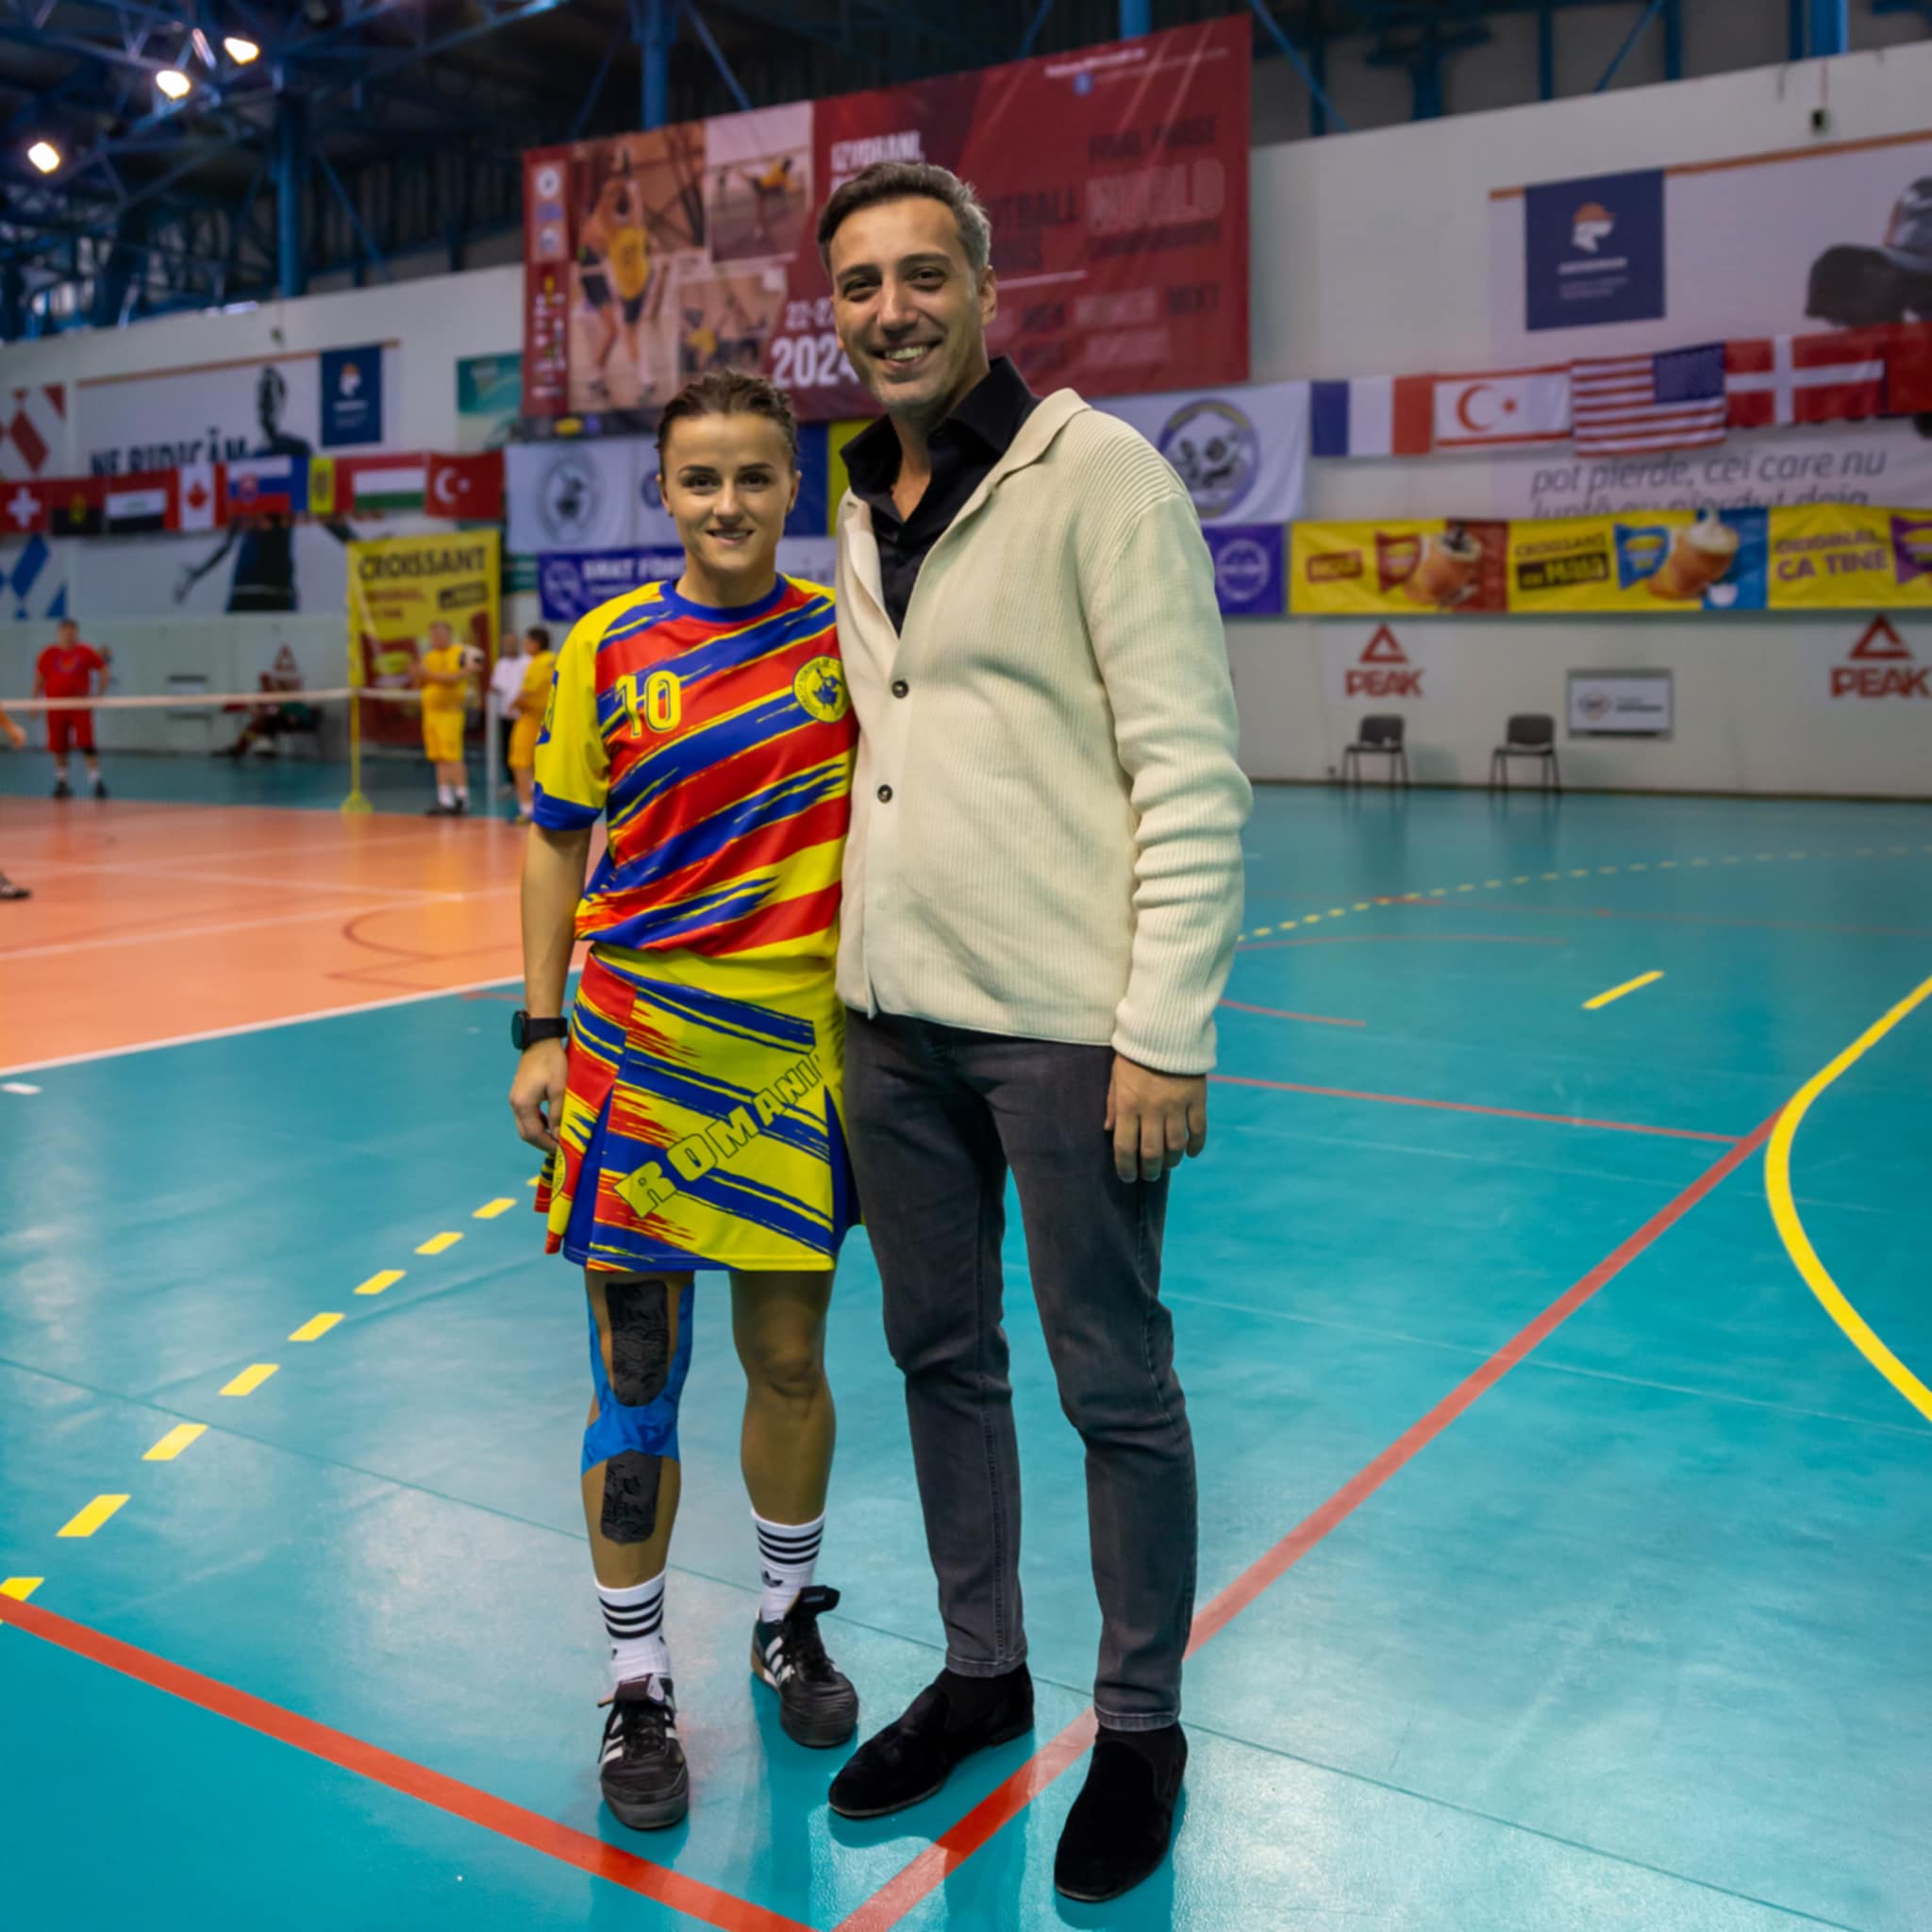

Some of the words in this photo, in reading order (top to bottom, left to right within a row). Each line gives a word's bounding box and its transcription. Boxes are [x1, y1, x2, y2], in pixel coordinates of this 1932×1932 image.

[1530, 465, 1581, 502] pot
[1585, 453, 1695, 510] pierde,
[1705, 449, 1753, 484] cei
[1758, 451, 1836, 483] care
[1840, 448, 1888, 478] nu
[358, 545, 486, 581] CROISSANT
[1777, 558, 1817, 581] CA
[1823, 549, 1887, 576] TINE
[1344, 668, 1424, 698] PEAK
[1830, 667, 1932, 698] PEAK
[615, 670, 682, 739] 10
[613, 1047, 824, 1219] ROMANI
